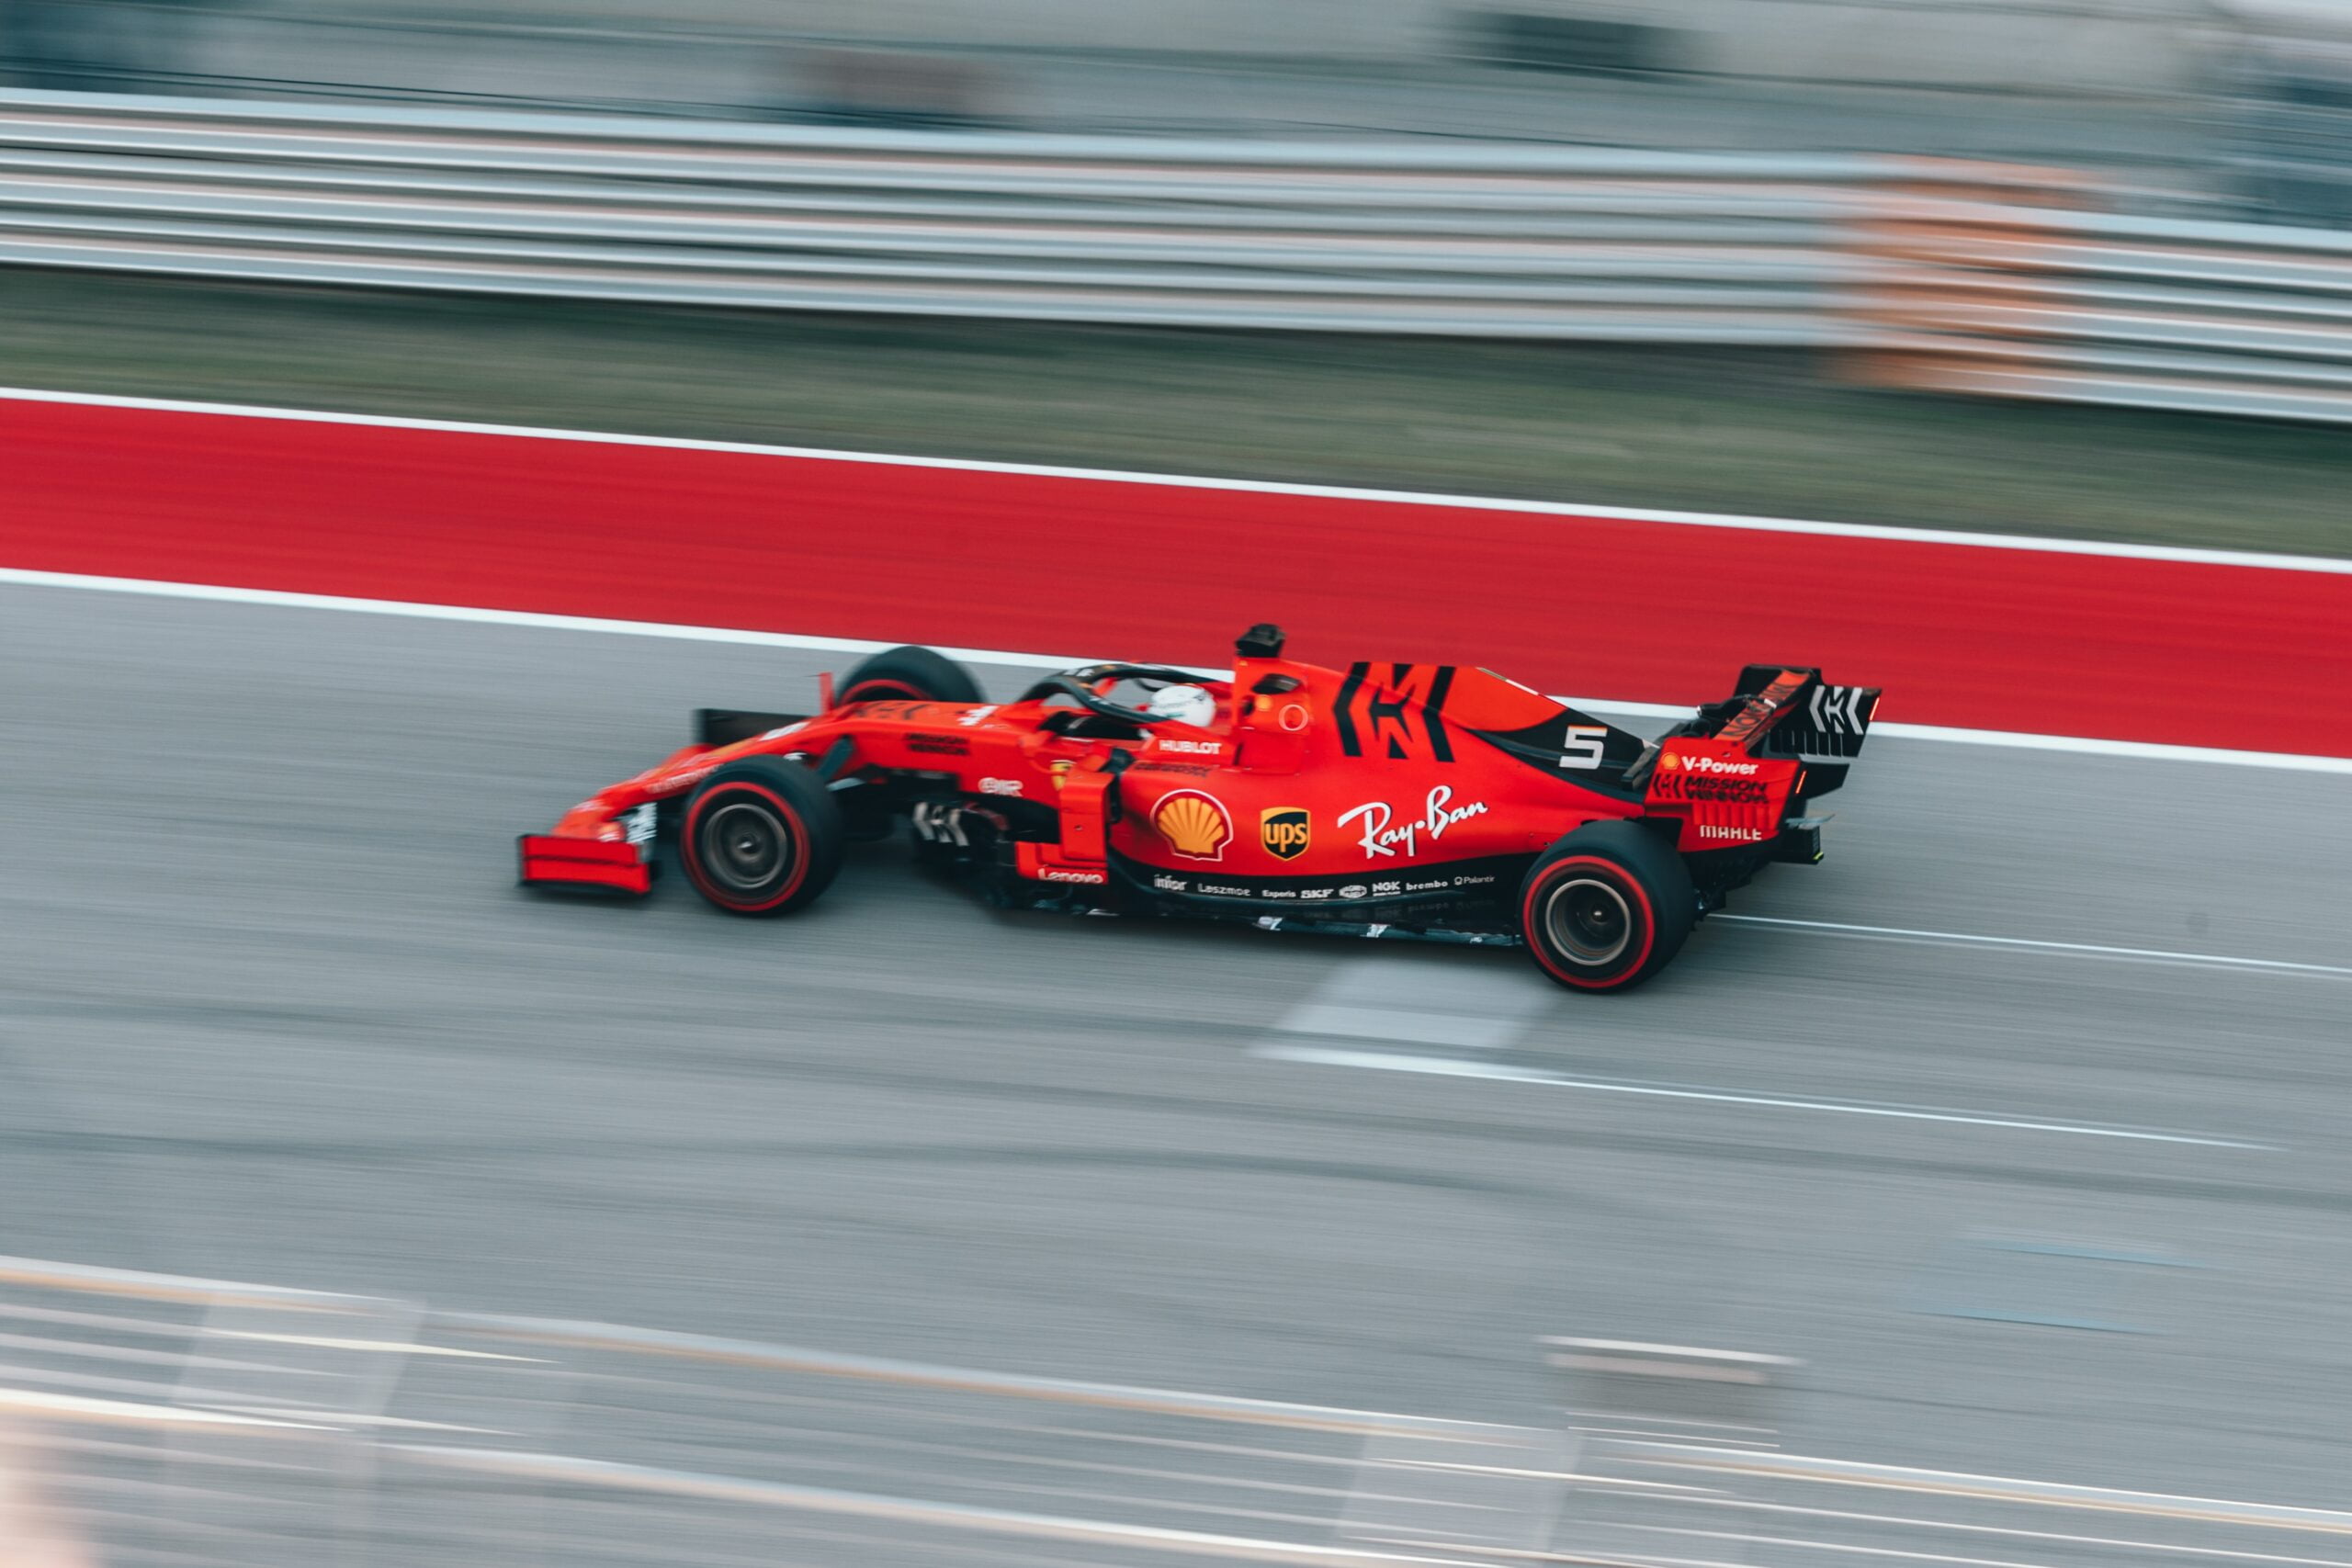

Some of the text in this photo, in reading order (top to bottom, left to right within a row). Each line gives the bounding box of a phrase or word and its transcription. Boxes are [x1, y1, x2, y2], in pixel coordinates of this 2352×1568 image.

[1159, 739, 1222, 755] HUBLOT
[1558, 725, 1608, 770] 5
[1681, 755, 1759, 775] V-Power
[1685, 775, 1768, 792] MISSION
[1264, 823, 1307, 852] ups
[1700, 825, 1762, 840] MAHLE
[1037, 867, 1103, 884] Lenovo
[1300, 888, 1334, 899] SKF
[1372, 881, 1401, 892] NGK
[1406, 880, 1449, 892] brembo
